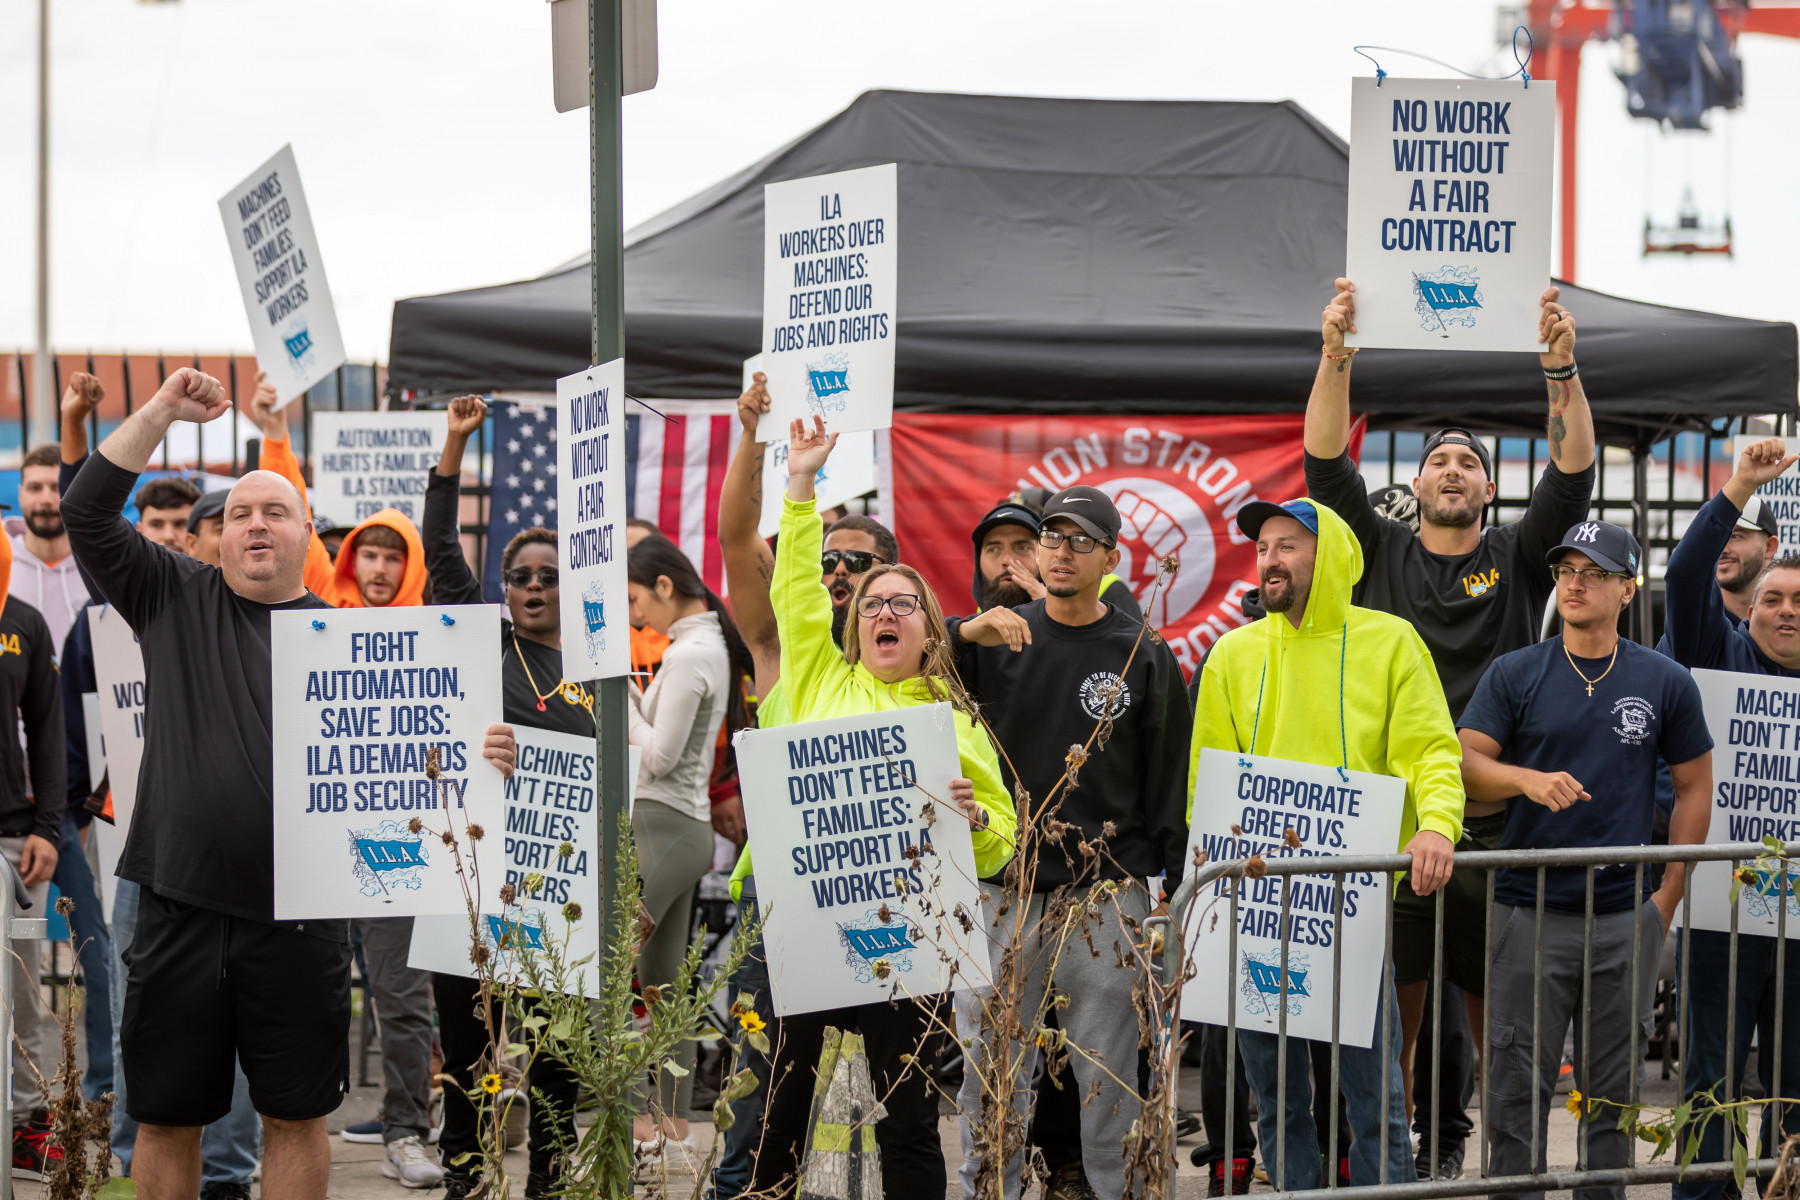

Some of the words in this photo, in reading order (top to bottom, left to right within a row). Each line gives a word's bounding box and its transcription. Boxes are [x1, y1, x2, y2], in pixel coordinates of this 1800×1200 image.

[1392, 99, 1427, 132] NO
[1434, 100, 1511, 134] WORK
[1393, 139, 1509, 174] WITHOUT
[237, 171, 282, 222] MACHINES
[821, 193, 841, 221] ILA
[1408, 179, 1426, 211] A
[1433, 180, 1490, 213] FAIR
[243, 210, 271, 250] DON'T
[268, 197, 291, 234] FEED
[779, 224, 845, 259] WORKERS
[848, 218, 885, 248] OVER
[1381, 217, 1517, 253] CONTRACT
[254, 257, 292, 304] SUPPORT
[289, 248, 308, 280] ILA
[794, 254, 868, 288] MACHINES:
[266, 279, 309, 327] WORKERS
[789, 288, 842, 320] DEFEND
[845, 283, 873, 311] OUR
[1428, 286, 1474, 305] I.L.A.
[771, 324, 804, 354] JOBS
[807, 319, 836, 349] AND
[838, 313, 888, 343] RIGHTS
[815, 374, 847, 392] I.L.A.
[571, 395, 583, 436] NO
[584, 387, 610, 432] WORK
[337, 429, 432, 447] AUTOMATION
[322, 453, 370, 472] HURTS
[571, 433, 610, 480] WITHOUT
[1012, 431, 1109, 496] ION
[342, 478, 365, 496] ILA
[369, 478, 426, 496] STANDS
[577, 487, 584, 524] A
[585, 481, 605, 520] FAIR
[570, 524, 614, 571] CONTRACT
[1573, 522, 1601, 544] NY
[351, 631, 418, 663] FIGHT
[305, 667, 465, 702] AUTOMATION,
[320, 706, 381, 738] SAVE
[387, 704, 451, 736] JOBS:
[1728, 718, 1790, 750] DON'T
[306, 745, 343, 776] ILA
[516, 743, 594, 781] CHINES
[787, 725, 907, 770] MACHINES
[305, 781, 346, 813] JOB
[354, 778, 469, 811] SECURITY
[504, 775, 540, 804] N'T
[542, 780, 594, 813] FEED
[787, 768, 853, 806] DON'T
[860, 759, 917, 795] FEED
[1237, 772, 1362, 817] CORPORATE
[1717, 781, 1800, 815] SUPPOR
[504, 805, 580, 843] MILIES:
[802, 796, 913, 839] FAMILIES:
[1317, 817, 1347, 849] VS.
[370, 845, 418, 864] I.L.A.
[505, 837, 555, 870] PORT
[791, 833, 892, 876] SUPPORT
[859, 933, 907, 952] I.L.A.
